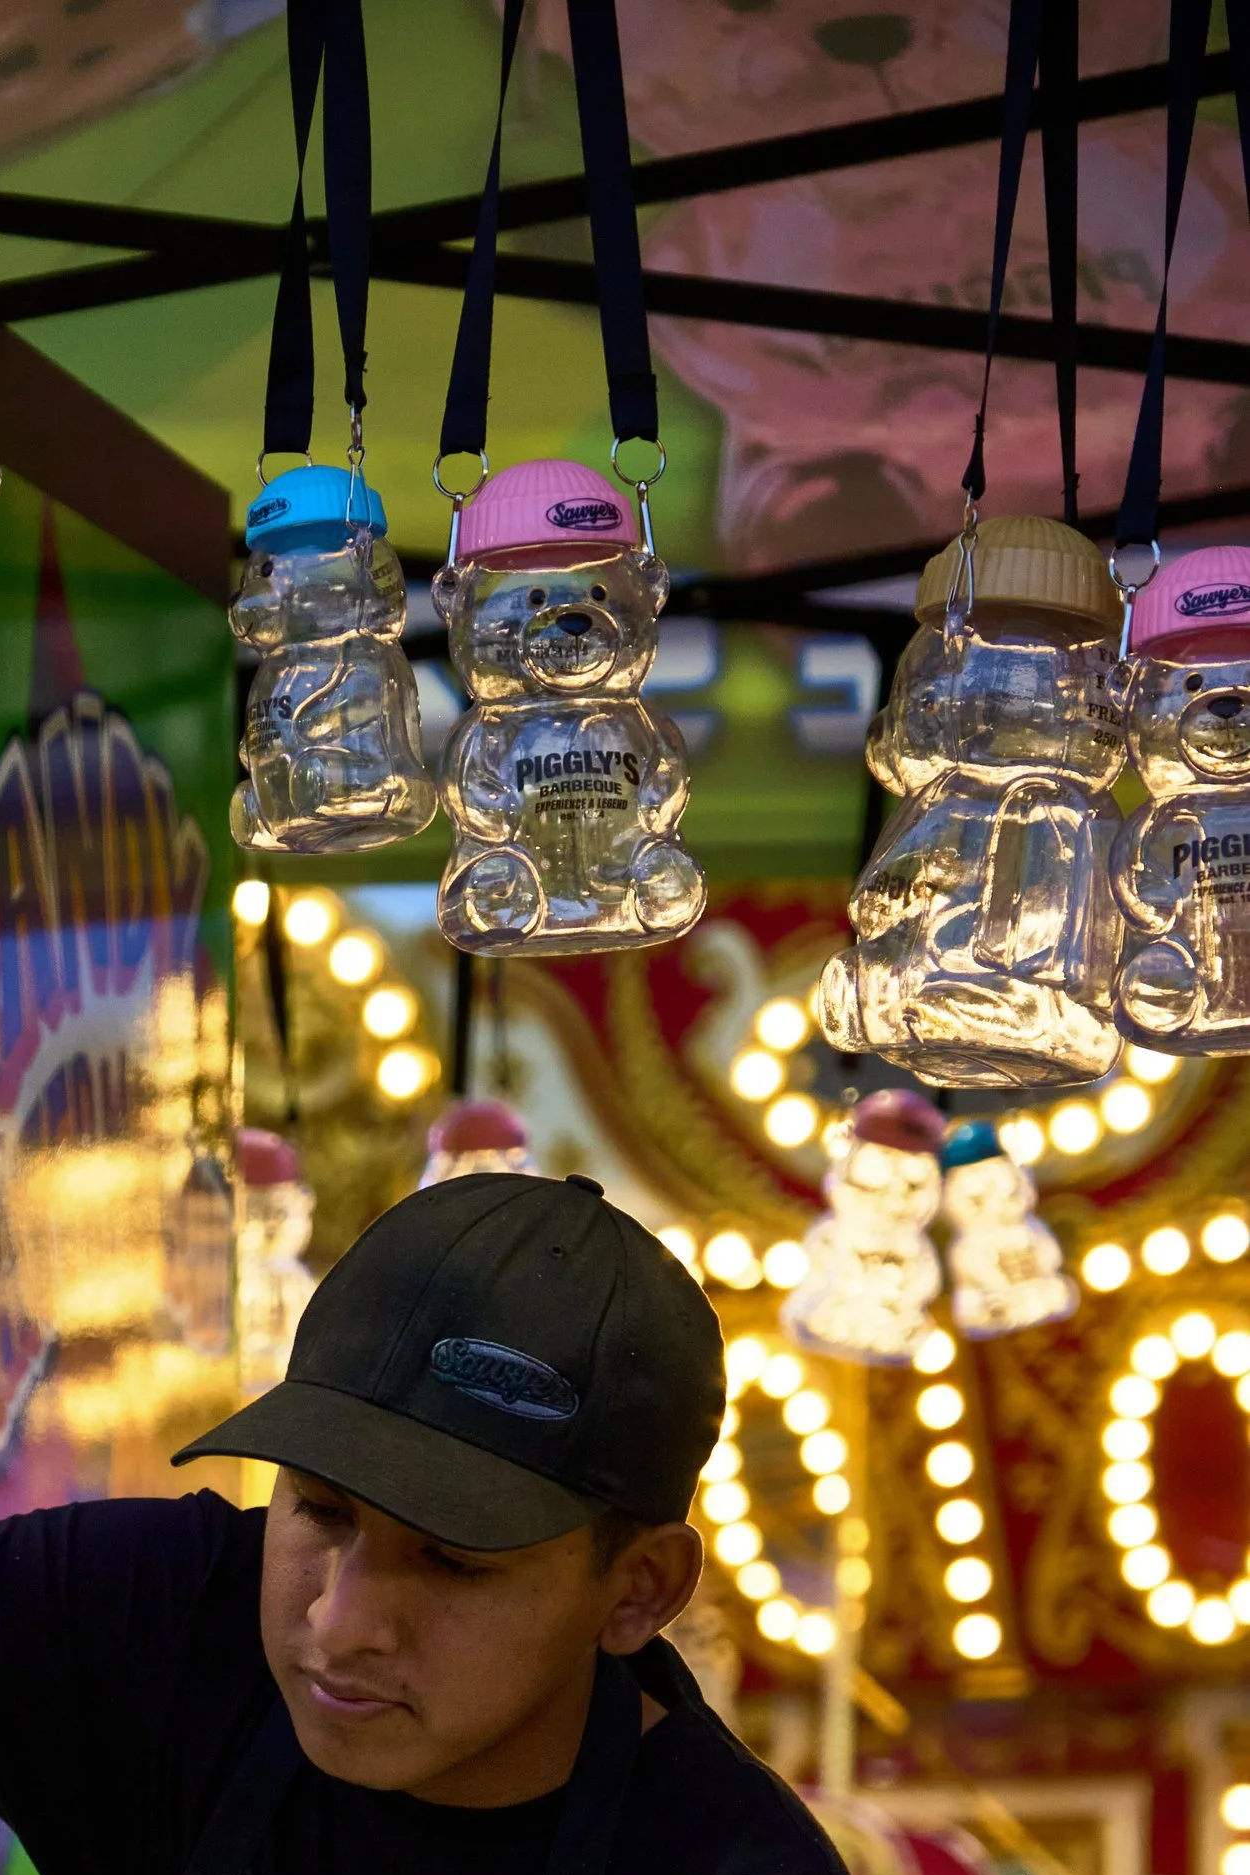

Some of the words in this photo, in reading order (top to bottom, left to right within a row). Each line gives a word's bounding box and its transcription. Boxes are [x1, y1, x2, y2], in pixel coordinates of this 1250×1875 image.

[553, 502, 619, 527] Sawyers
[1180, 585, 1250, 614] Sawyer
[516, 750, 640, 792] PIGGLY'S
[539, 779, 623, 798] BARBEQUE
[535, 798, 587, 813] EXPERIENCE
[588, 799, 595, 809] A
[597, 799, 628, 810] LEGEND
